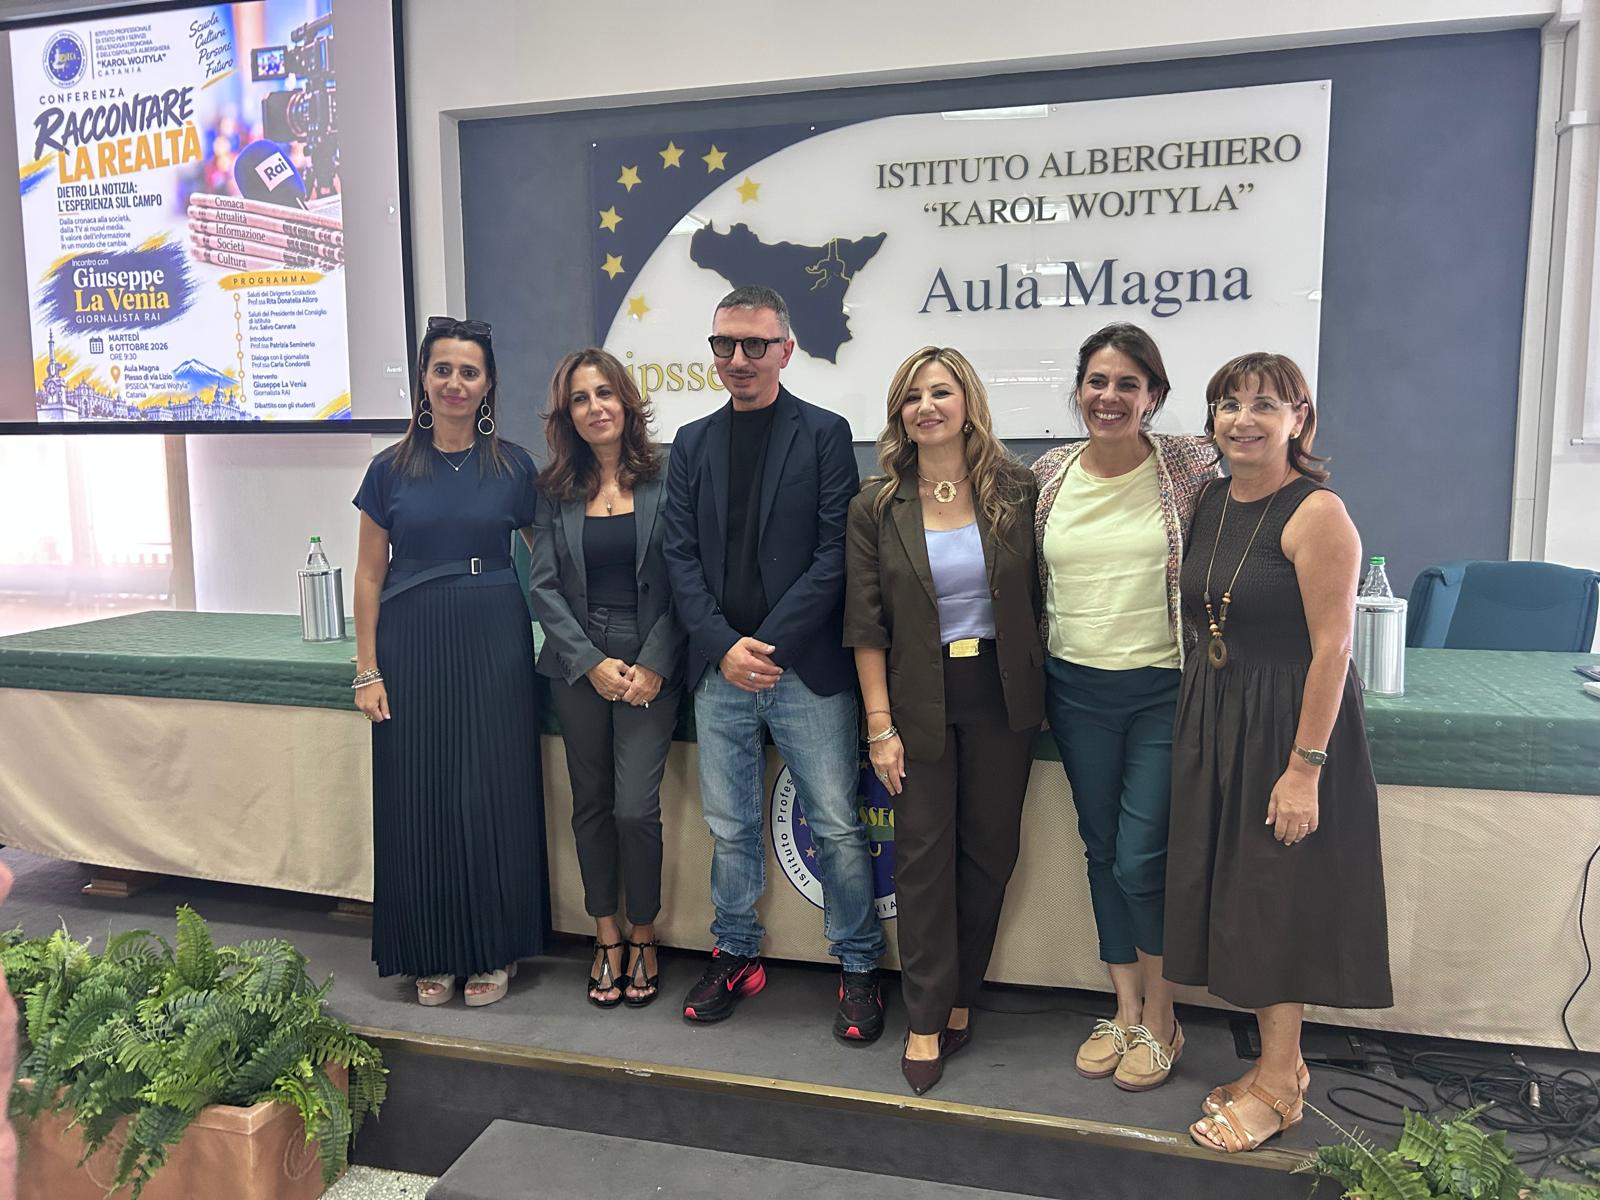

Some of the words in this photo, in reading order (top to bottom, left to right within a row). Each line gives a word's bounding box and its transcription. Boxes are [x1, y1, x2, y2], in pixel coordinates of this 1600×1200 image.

[189, 11, 219, 38] Scuola
[195, 28, 226, 49] Cultura
[198, 42, 232, 65] Persone
[98, 66, 142, 77] CATANIA
[206, 59, 233, 78] Futuro
[39, 88, 125, 104] CONFERENZA
[58, 146, 95, 185] LA
[97, 120, 203, 178] REALTÀ
[875, 154, 1029, 190] ISTITUTO
[1038, 133, 1302, 180] ALBERGHIERO
[264, 158, 288, 181] Rai
[57, 184, 87, 199] DIETRO
[90, 184, 100, 196] LA
[102, 182, 138, 195] NOTIZIA:
[116, 196, 131, 209] SUL
[132, 194, 162, 207] CAMPO
[214, 197, 244, 210] Cronaca
[59, 218, 74, 226] Dalla
[216, 210, 248, 224] Attualità
[60, 226, 74, 234] dalla
[216, 224, 266, 241] Informazione
[216, 238, 246, 252] Società
[72, 259, 97, 267] Incontro
[217, 253, 247, 268] Cultura
[73, 267, 165, 291] Giuseppe
[234, 276, 306, 285] PROGRAMMA
[918, 263, 1043, 314] Aula
[1062, 258, 1252, 318] Magna
[74, 289, 104, 312] La
[106, 285, 170, 311] Venia
[76, 313, 140, 324] GIORNALISTA
[144, 312, 160, 321] RAI
[108, 331, 140, 342] MARTEDÌ
[110, 344, 114, 352] 6
[115, 343, 149, 351] OTTOBRE
[150, 342, 168, 351] 2026
[139, 365, 160, 373] Magna
[626, 351, 726, 402] ipsse
[289, 380, 307, 388] Venia
[126, 391, 147, 399] Catania
[777, 778, 793, 823] Profes
[781, 833, 810, 887] Istituto
